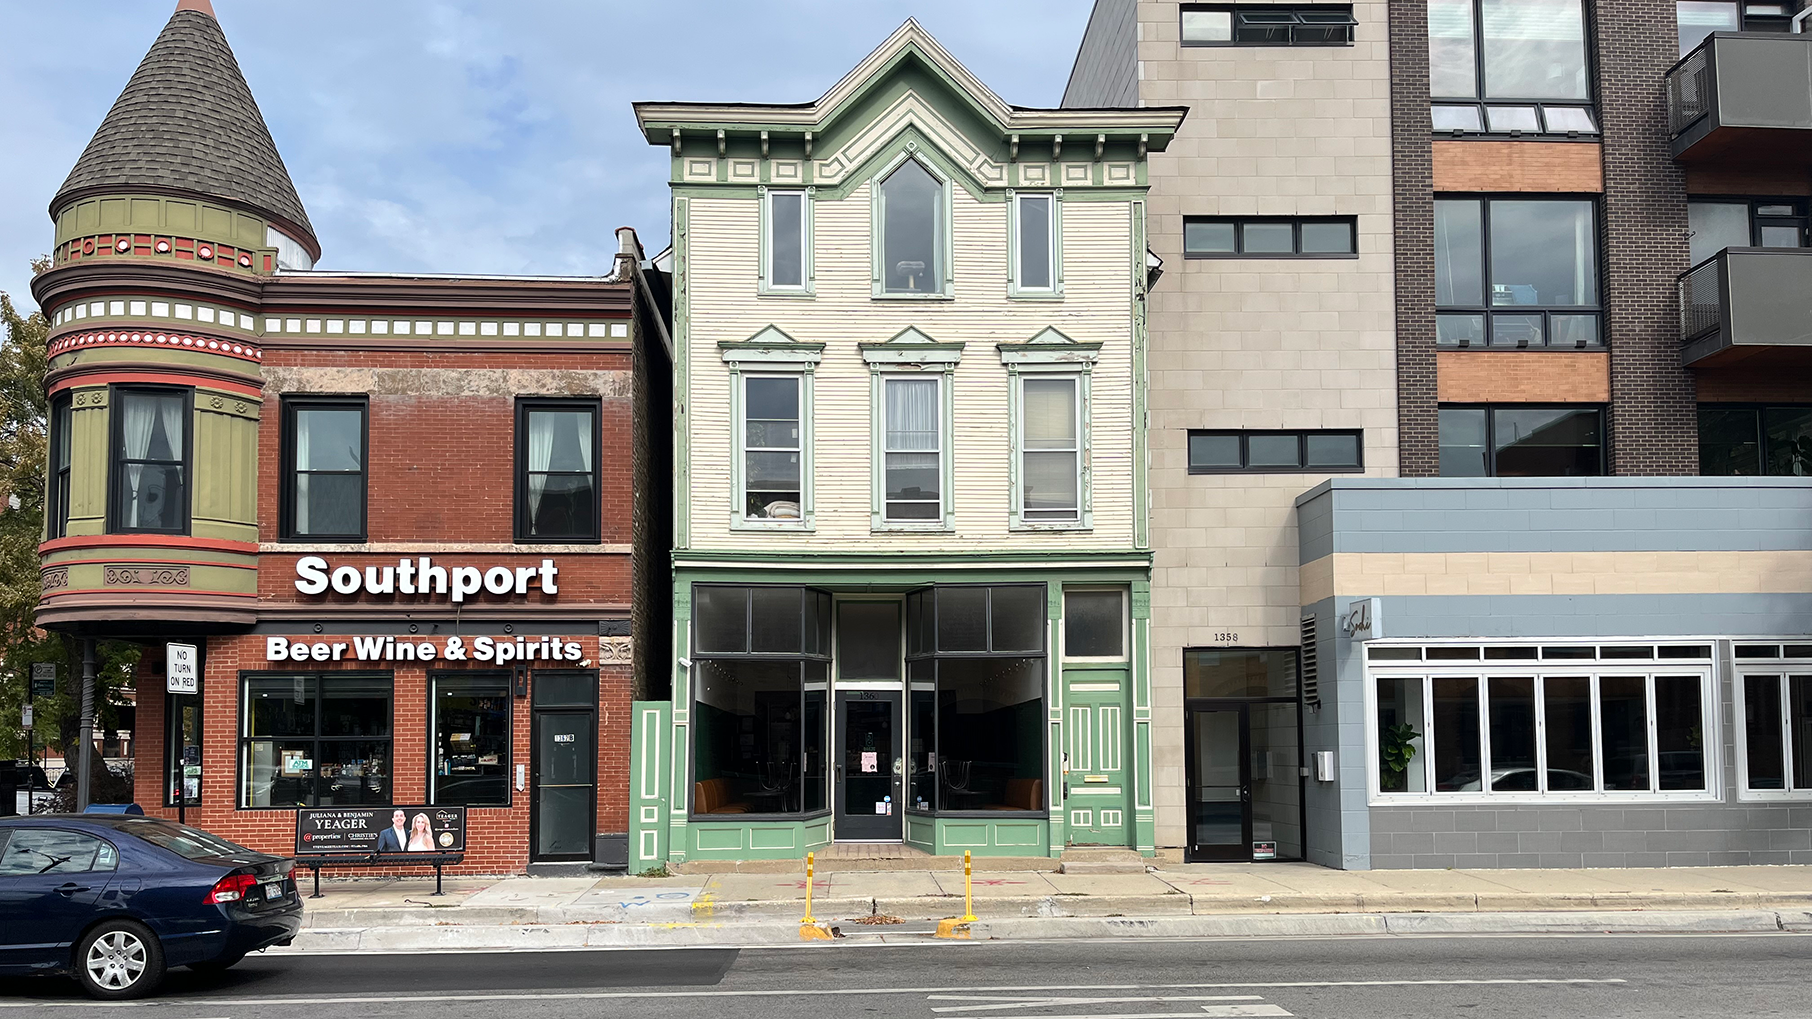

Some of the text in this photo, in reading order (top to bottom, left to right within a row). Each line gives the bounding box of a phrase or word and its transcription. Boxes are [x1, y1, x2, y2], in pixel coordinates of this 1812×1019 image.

[294, 556, 558, 602] Southport
[1214, 632, 1239, 642] 1358
[177, 651, 188, 660] NO
[266, 636, 583, 665] Beer Wine & Spirits
[174, 663, 191, 674] TURN
[170, 676, 195, 687] ON RED
[315, 819, 367, 829] YEAGER
